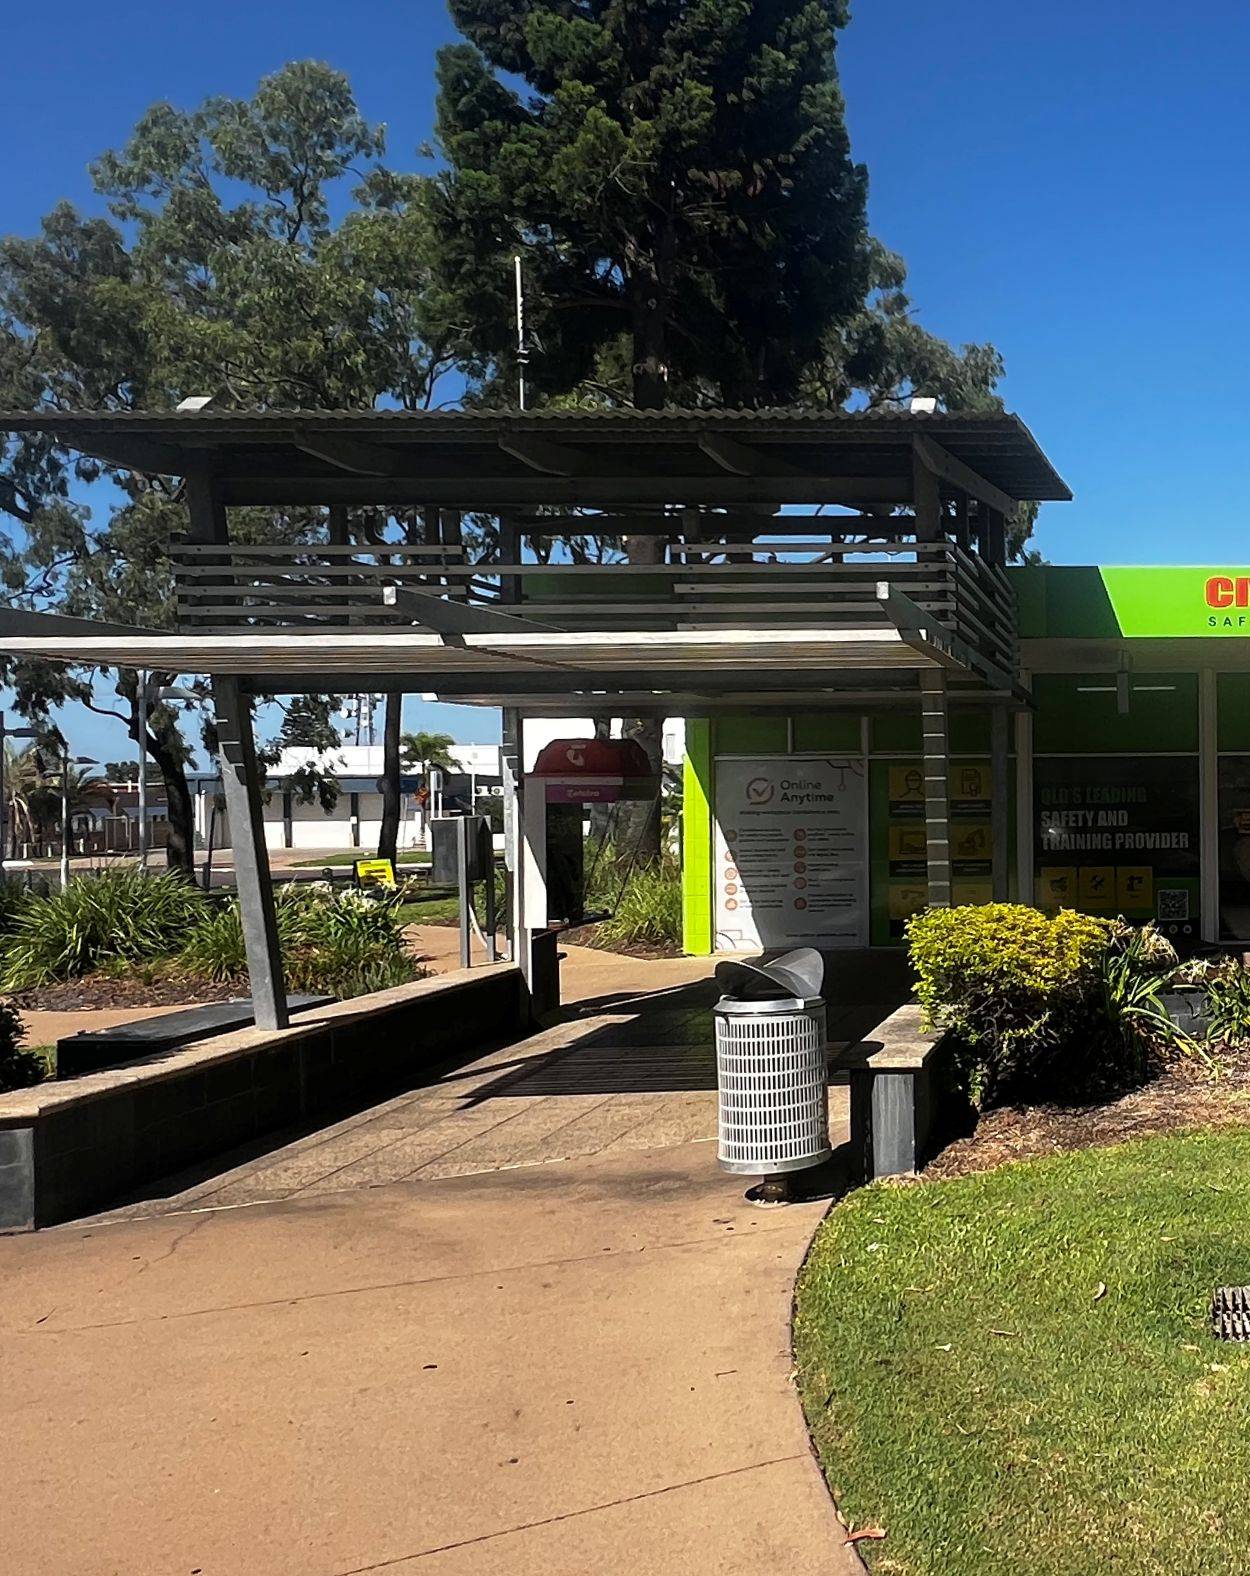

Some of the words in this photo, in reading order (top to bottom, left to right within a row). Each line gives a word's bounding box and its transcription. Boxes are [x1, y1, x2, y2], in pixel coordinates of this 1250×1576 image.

[780, 779, 822, 790] Online
[780, 792, 834, 804] Anytime
[1041, 810, 1095, 827] SAFETY
[1097, 810, 1129, 826] AND
[1041, 832, 1112, 850] TRAINING
[1115, 832, 1189, 849] PROVIDER
